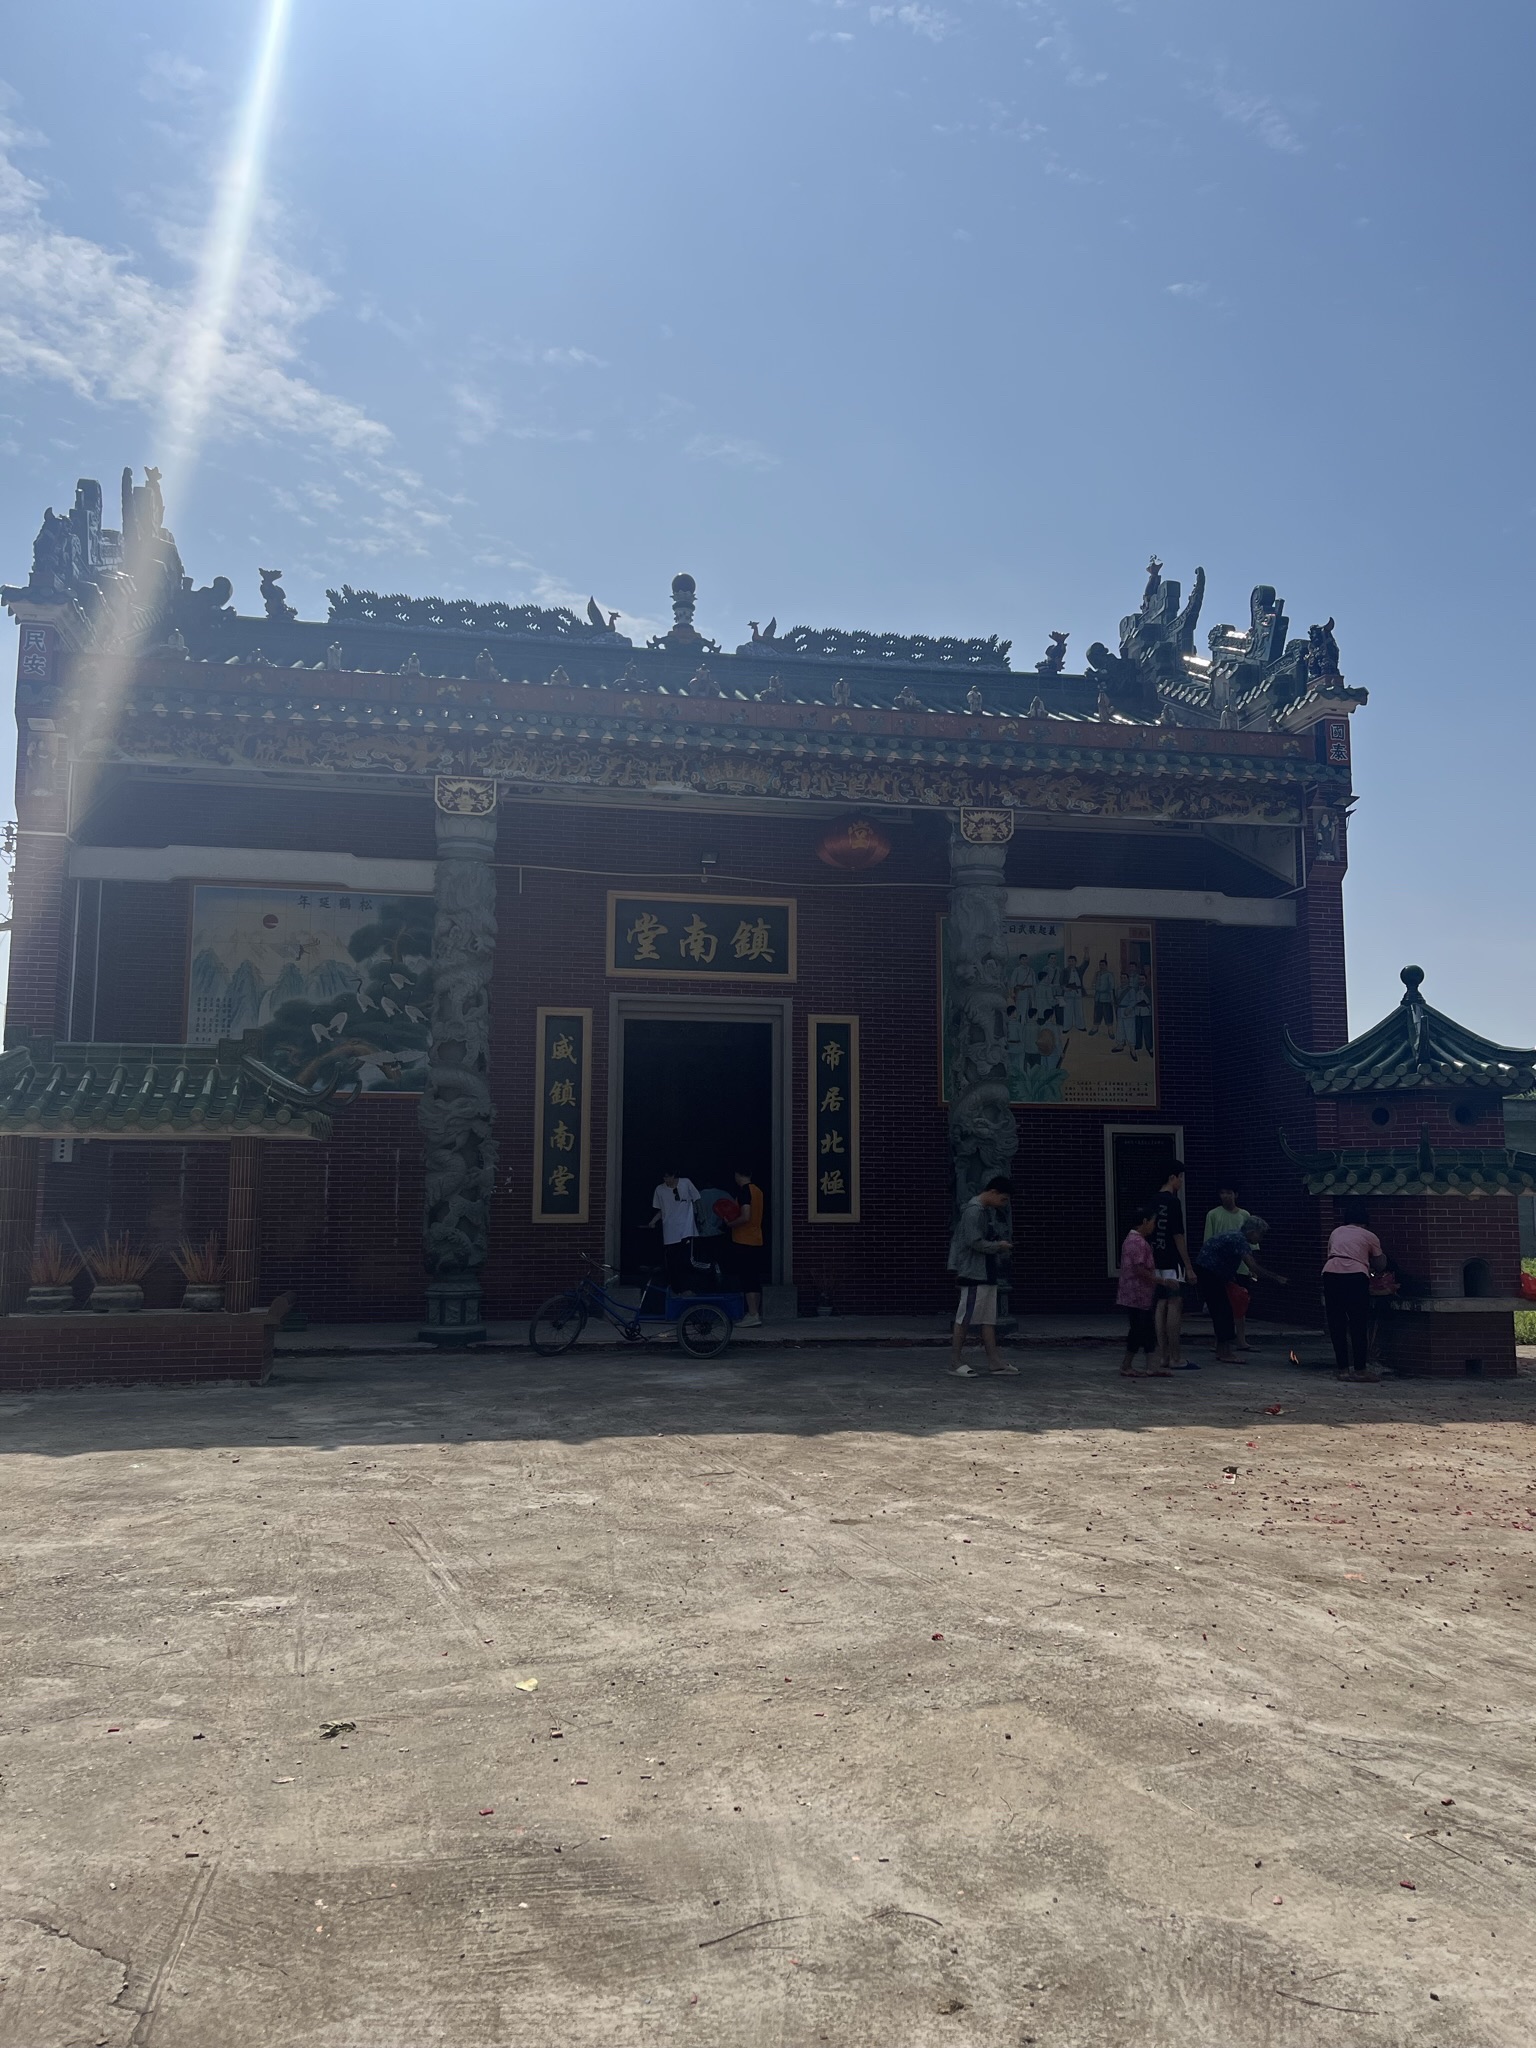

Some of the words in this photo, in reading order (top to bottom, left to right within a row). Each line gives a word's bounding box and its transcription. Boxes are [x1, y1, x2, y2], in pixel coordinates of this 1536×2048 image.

[23, 629, 46, 676] 民安
[1330, 724, 1348, 761] 國泰
[627, 912, 775, 963] 鎮南堂
[549, 1033, 577, 1196] 威鎮南堂
[820, 1041, 846, 1196] 帝居北極
